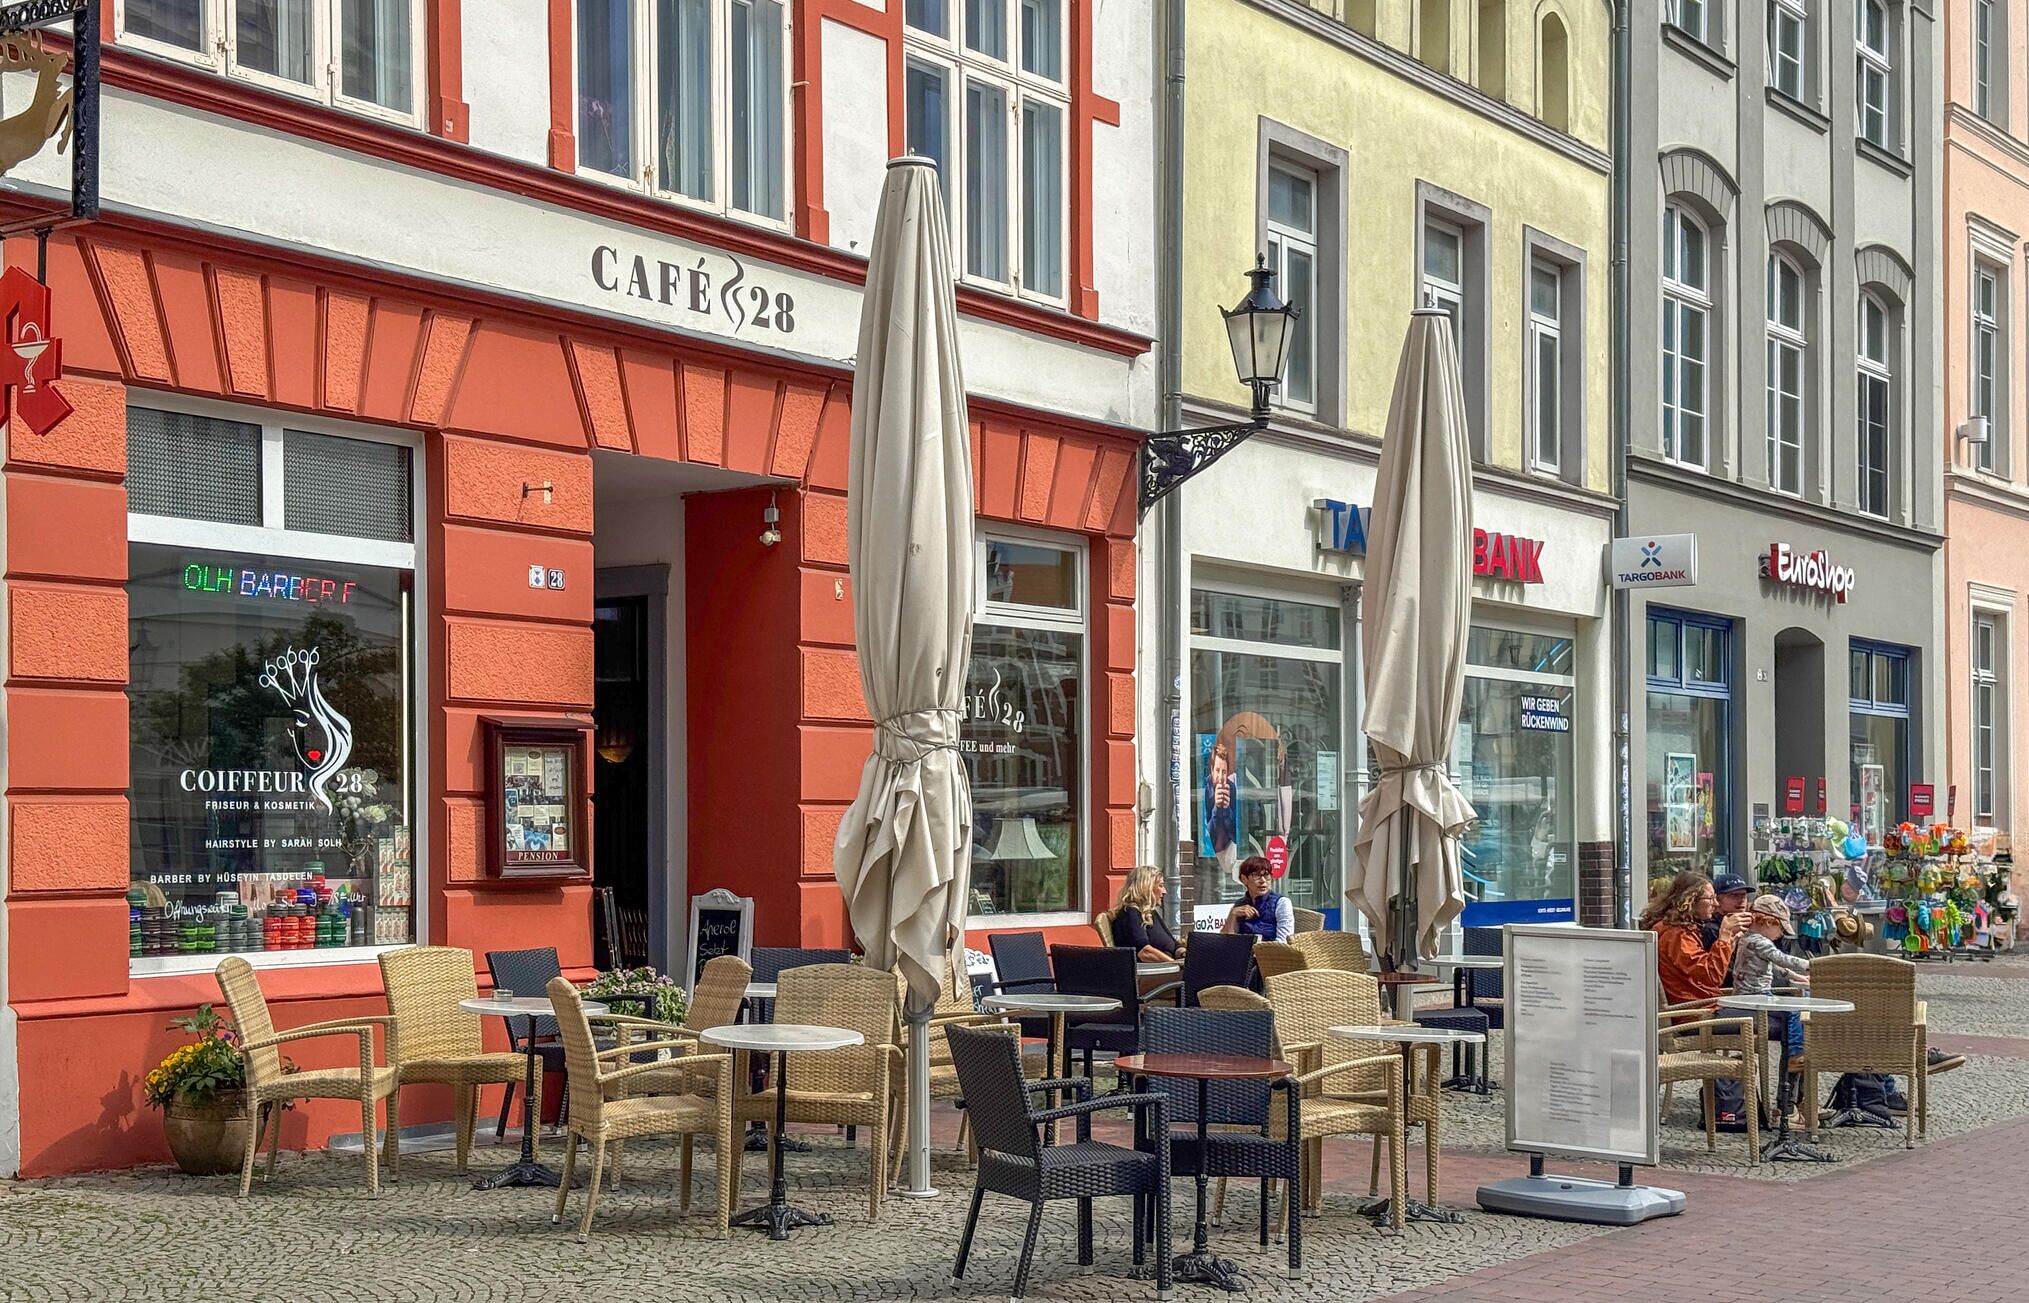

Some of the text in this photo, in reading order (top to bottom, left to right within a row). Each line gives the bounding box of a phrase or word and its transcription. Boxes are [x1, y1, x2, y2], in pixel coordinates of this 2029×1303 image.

[591, 245, 795, 334] CAFÉ 28
[1473, 527, 1545, 584] BANK
[550, 571, 564, 588] 28
[1618, 569, 1686, 583] TARGOBANK
[963, 688, 1025, 733] FÉ 28
[1521, 696, 1560, 712] WIR GEBEN
[1521, 711, 1569, 731] RÜCKENWIND
[960, 740, 1016, 754] FEE und mehr
[180, 769, 363, 793] COIFFEUR 28
[205, 800, 316, 810] FRISEUR & KOSMETIK
[205, 838, 343, 849] HAIRSTYLE BY SARAH SOLH
[518, 851, 559, 861] PENSION
[150, 871, 313, 884] BARBER BY HÜSEYIN TASDELEN
